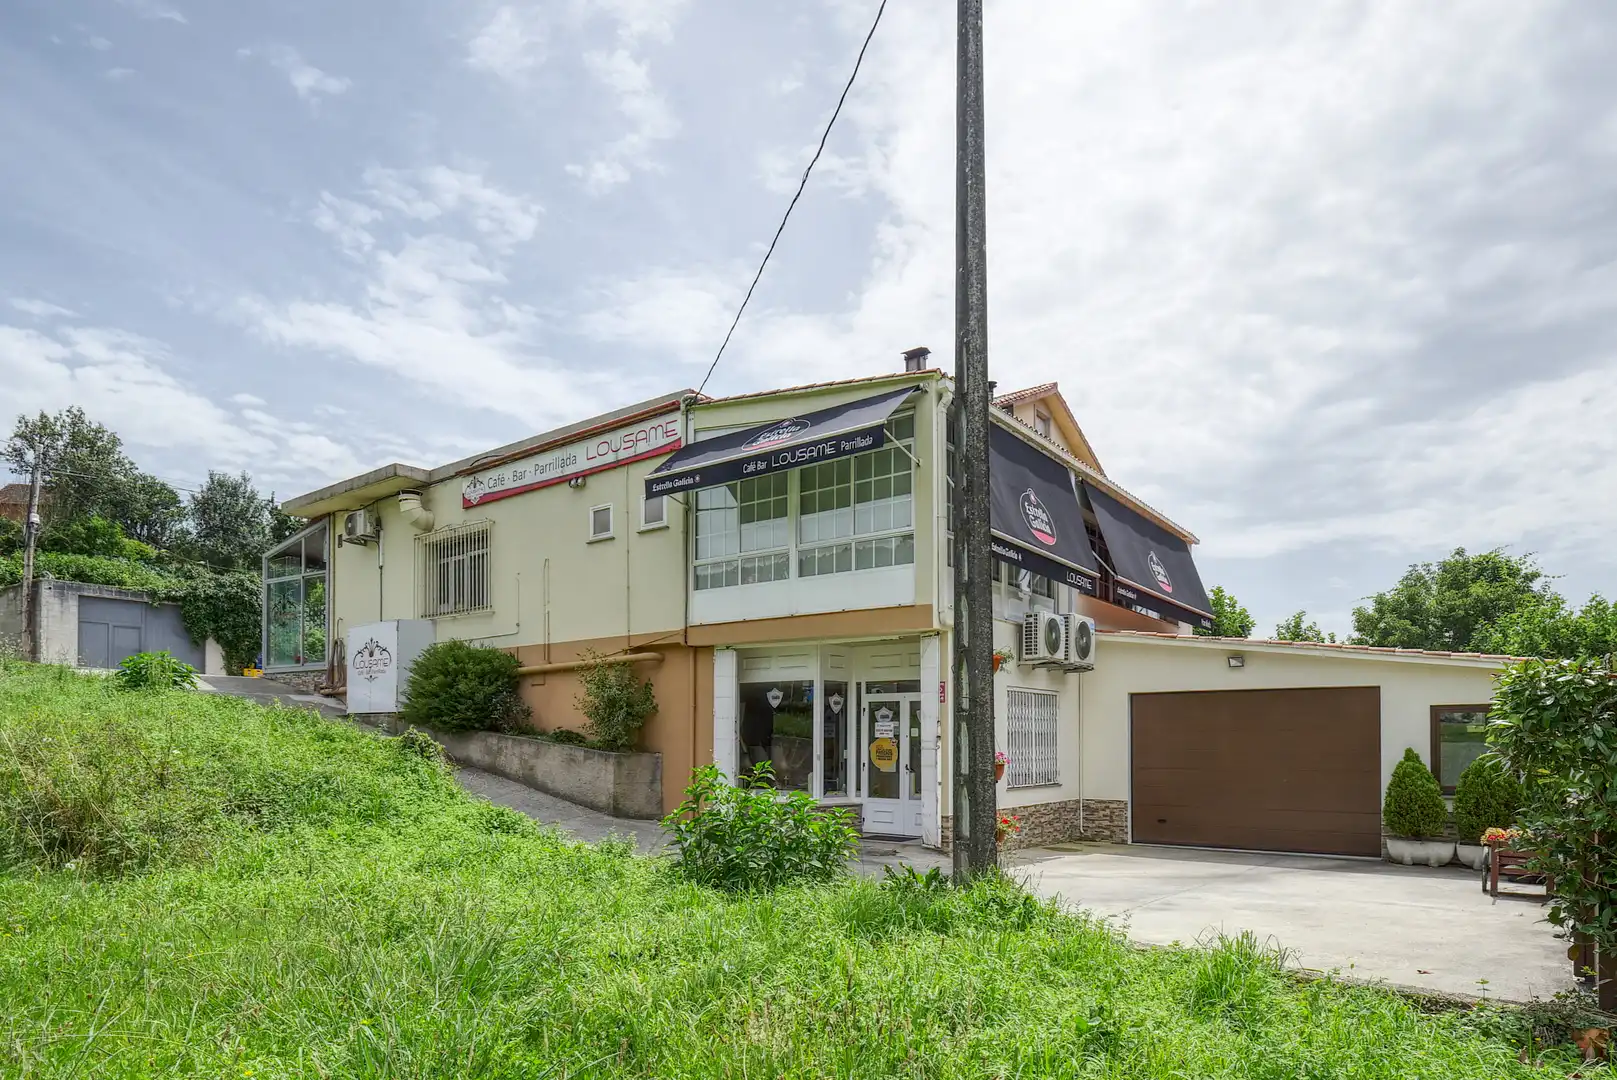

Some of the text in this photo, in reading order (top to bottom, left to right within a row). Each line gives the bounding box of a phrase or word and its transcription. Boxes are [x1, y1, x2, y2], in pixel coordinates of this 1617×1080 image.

[487, 419, 678, 490] Café Bar Parrillada LOUSAME
[742, 435, 873, 474] Café Bar LOUSAME Parrillada
[652, 476, 694, 492] Estrella Galicia
